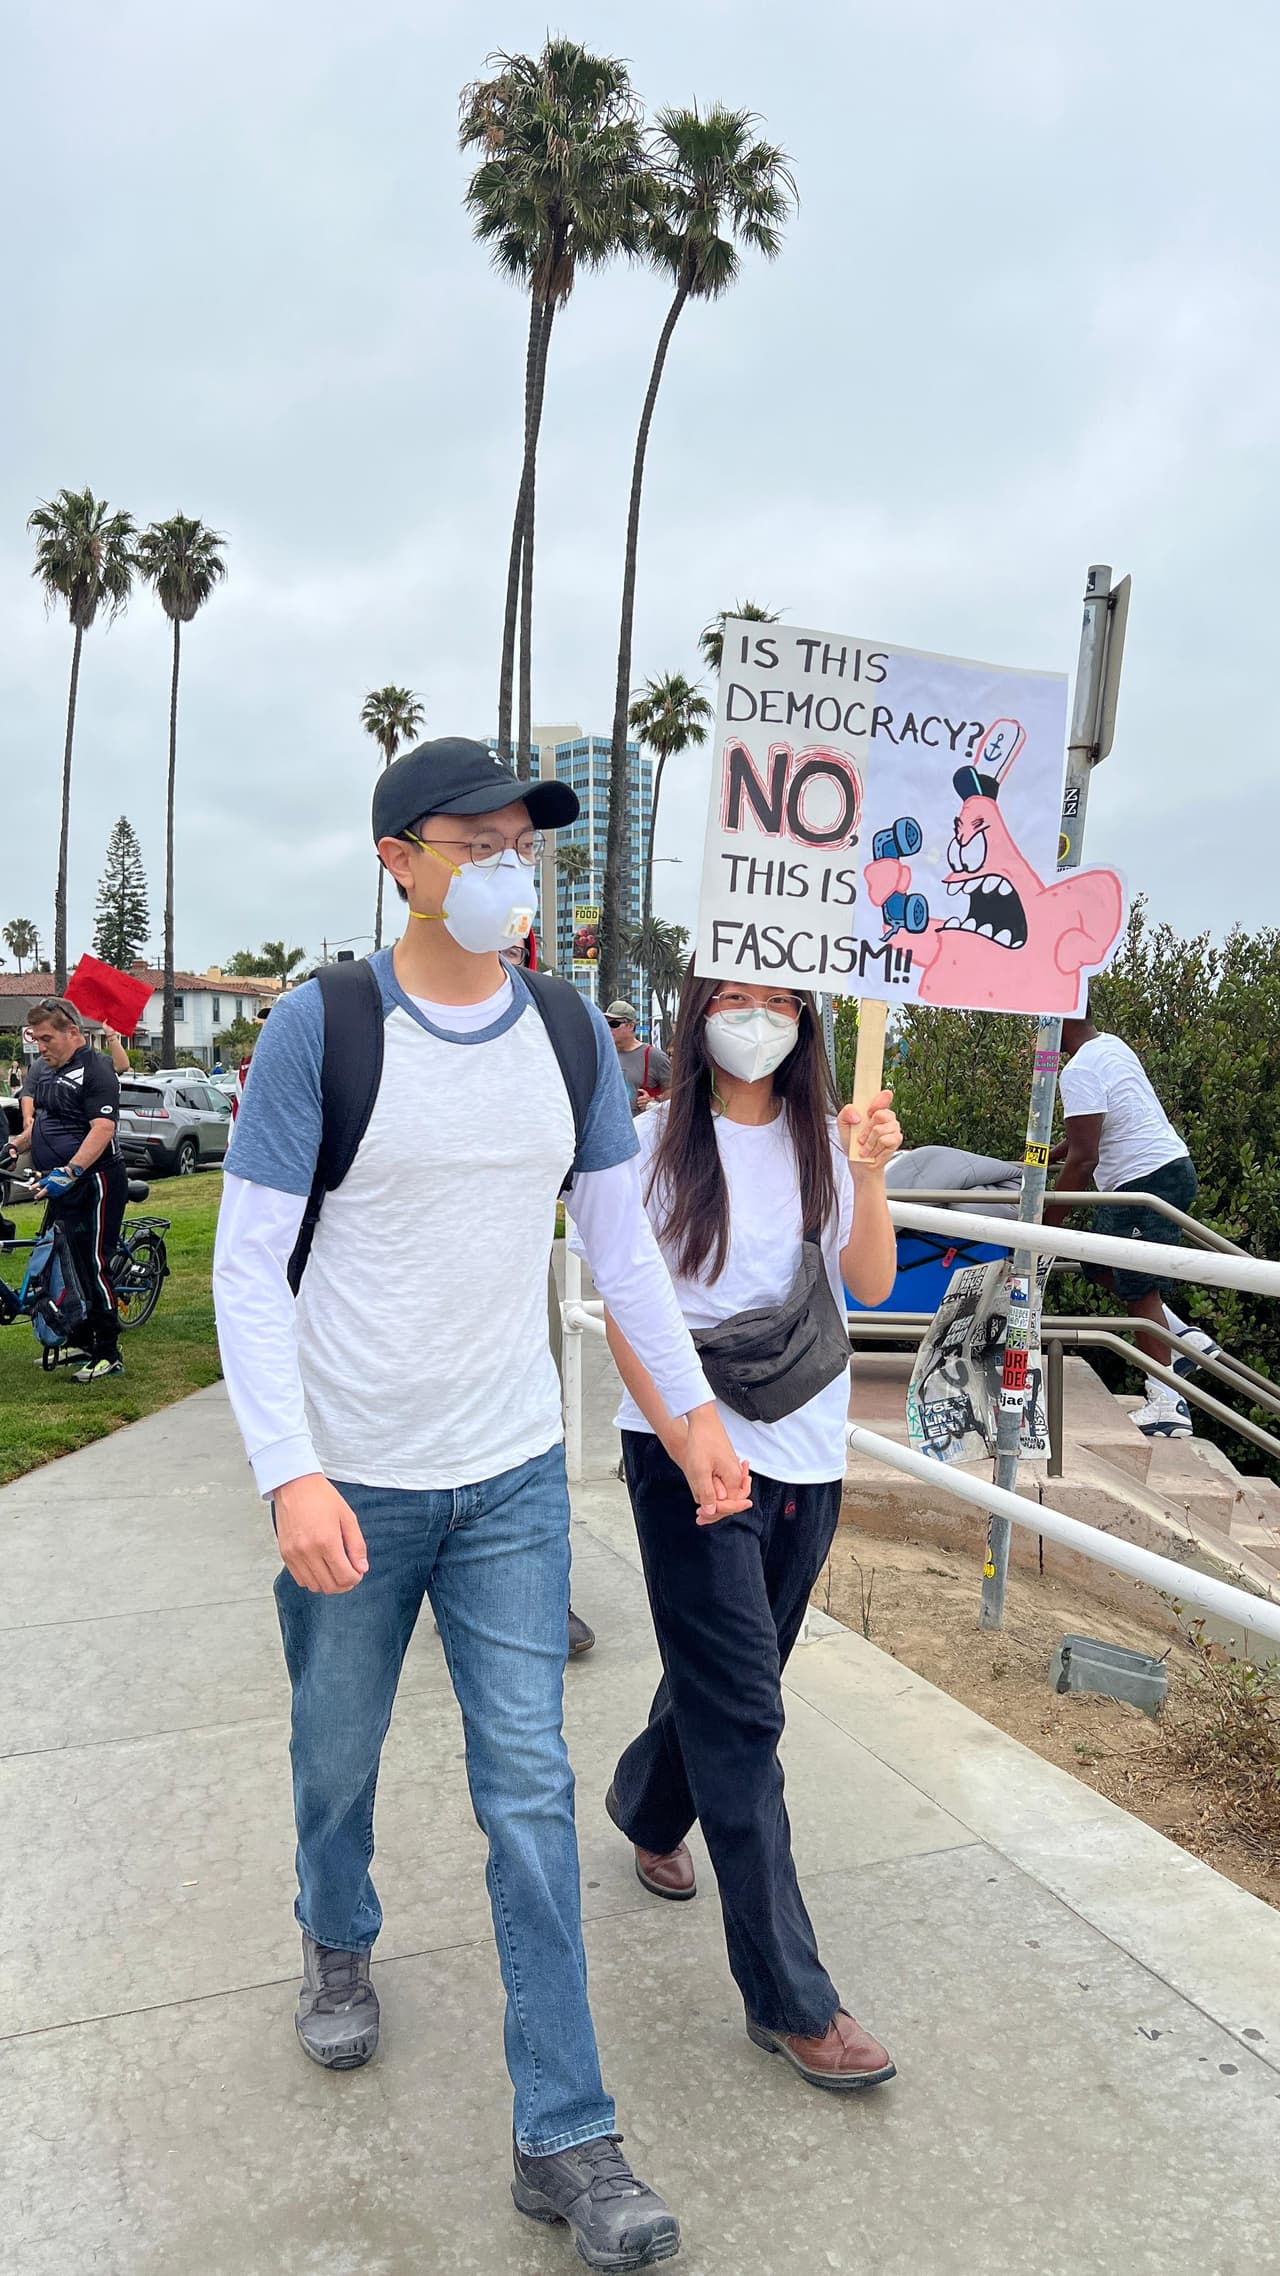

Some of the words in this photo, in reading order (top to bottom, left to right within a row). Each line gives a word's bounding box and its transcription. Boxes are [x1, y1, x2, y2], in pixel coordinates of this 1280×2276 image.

[740, 635, 780, 669] IS
[796, 638, 890, 684] THIS
[726, 683, 986, 759] DEMOCRACY?
[724, 744, 861, 848] NO,
[721, 853, 809, 898] THIS
[820, 867, 857, 905] IS
[575, 910, 598, 919] FOOD
[711, 919, 913, 984] FASCISM!!
[1000, 1392, 1024, 1407] jae
